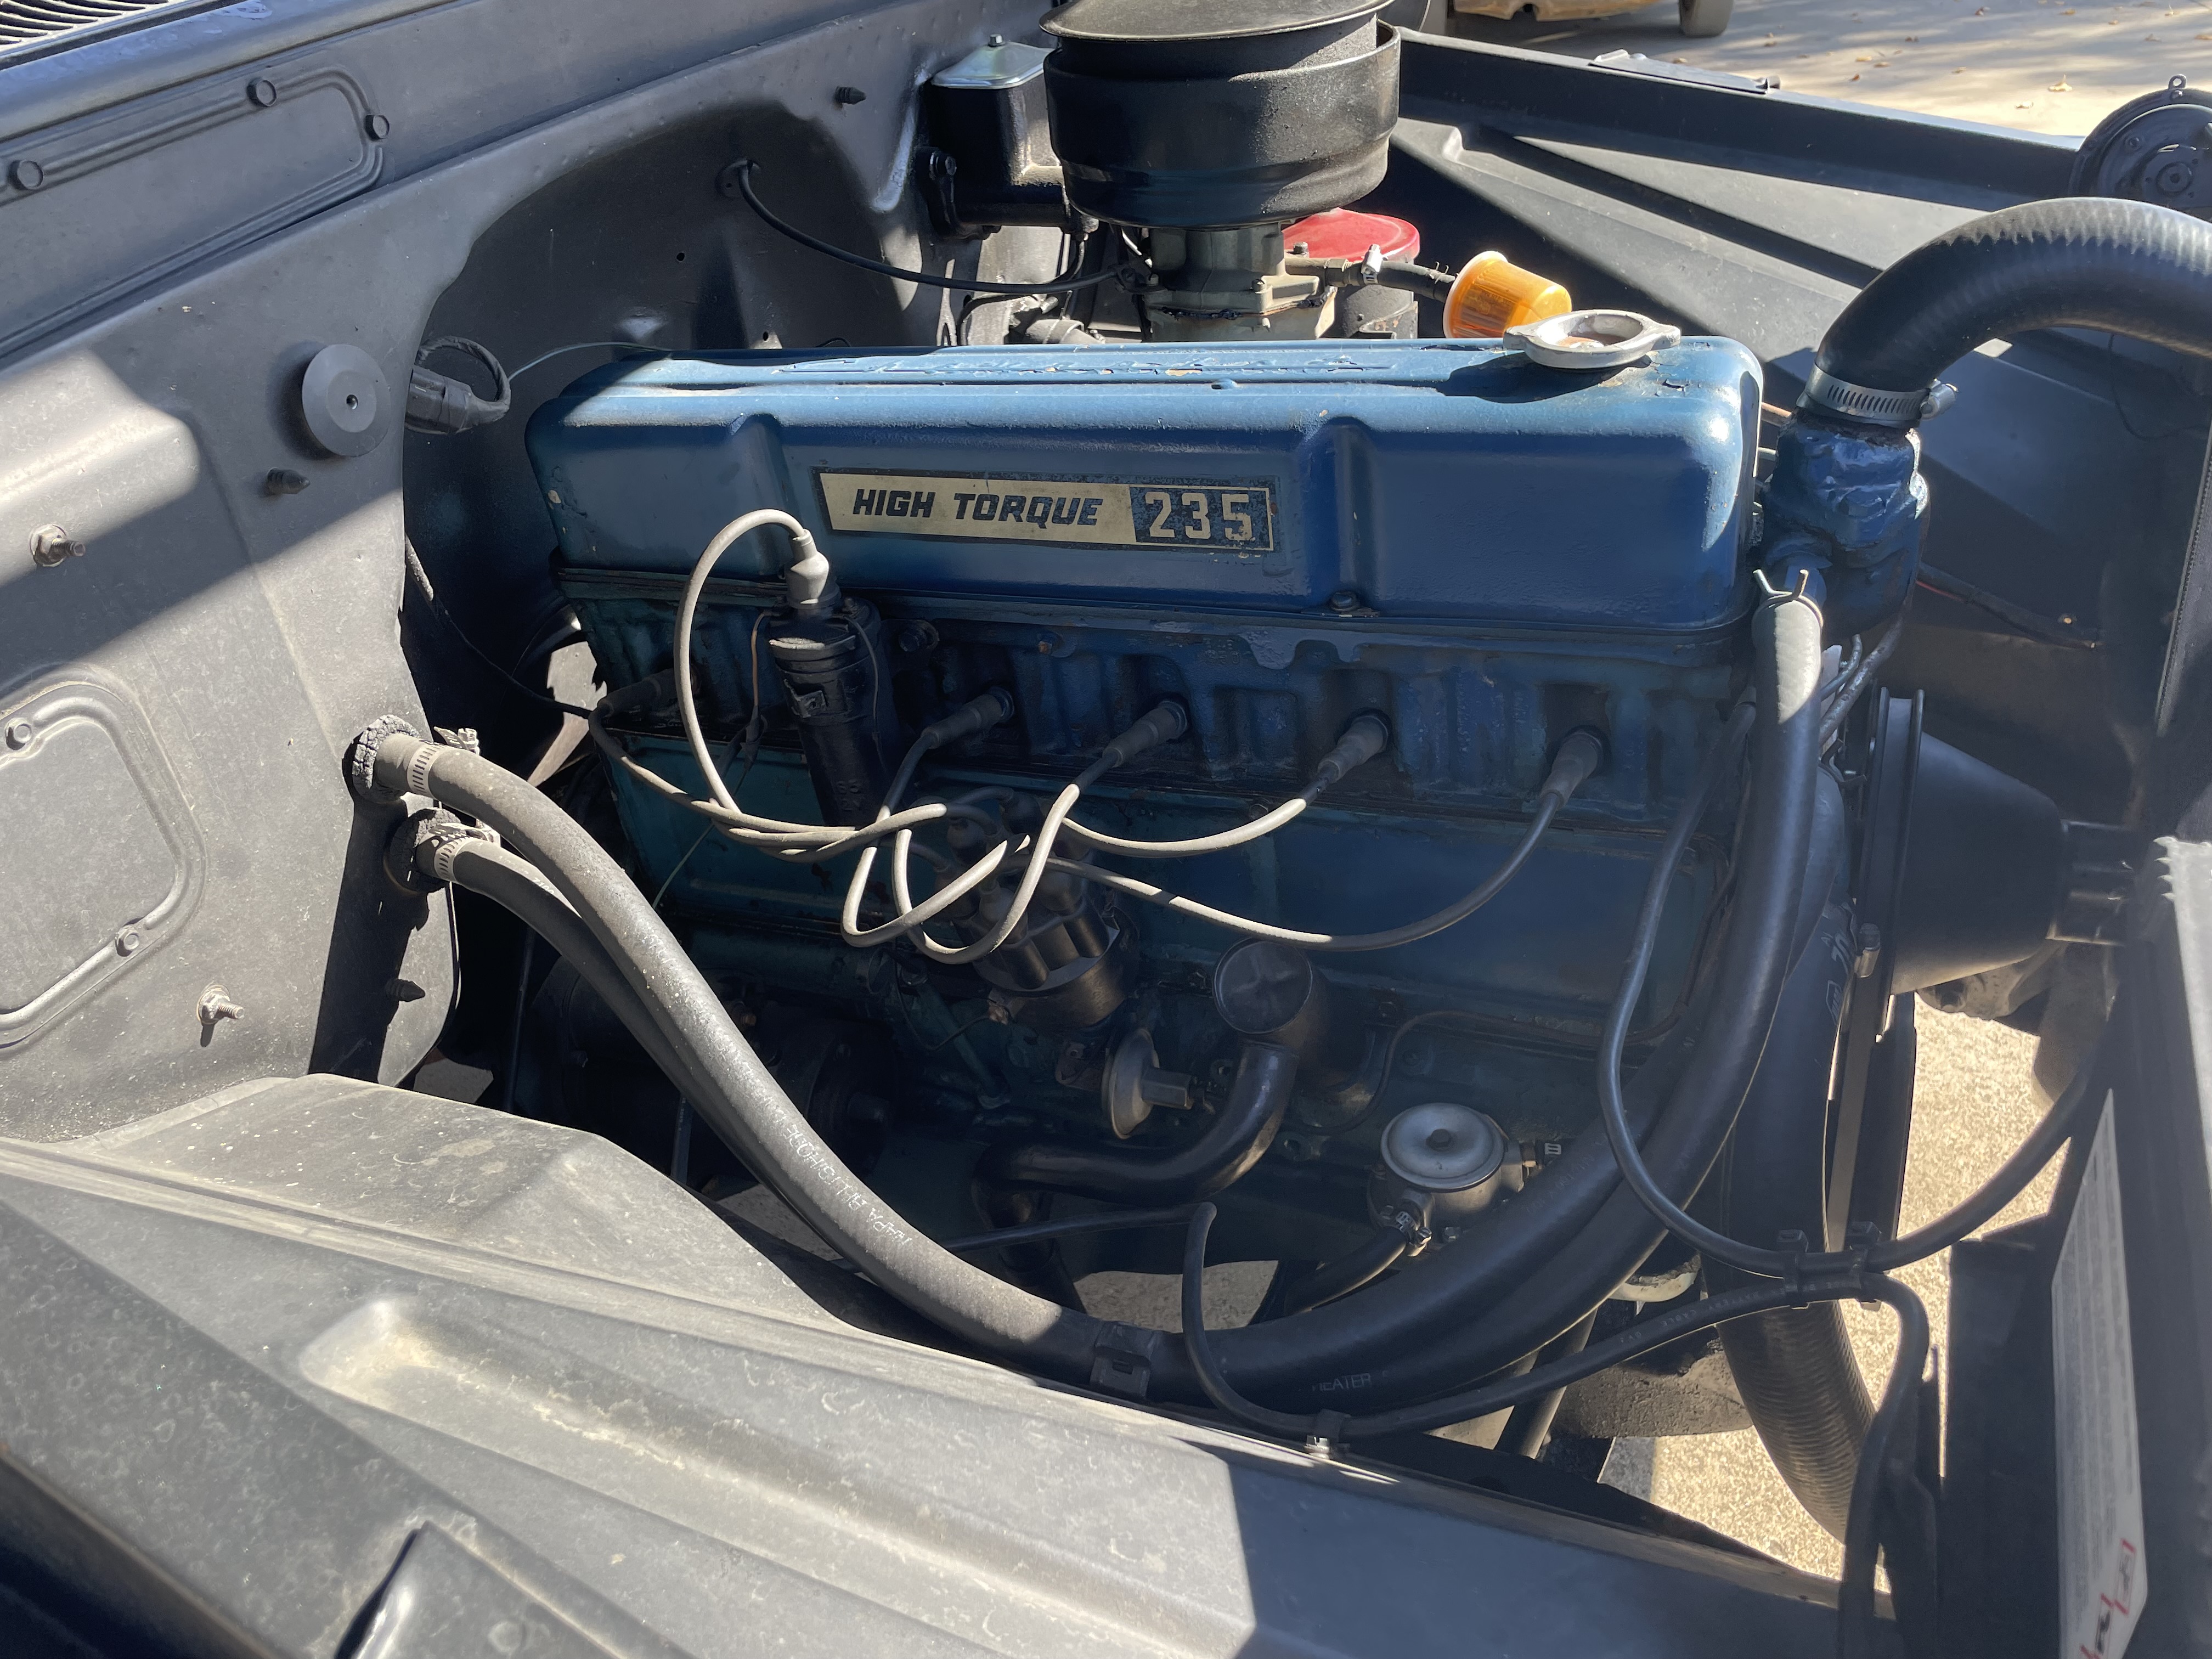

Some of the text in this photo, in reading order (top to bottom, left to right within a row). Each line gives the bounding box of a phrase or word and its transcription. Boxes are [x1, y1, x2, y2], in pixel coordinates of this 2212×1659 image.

[853, 489, 1252, 541] HIGH TORQUE 235
[865, 1207, 912, 1244] NAPA
[1660, 1311, 1697, 1328] CABLE
[1312, 1373, 1371, 1391] HEATER
